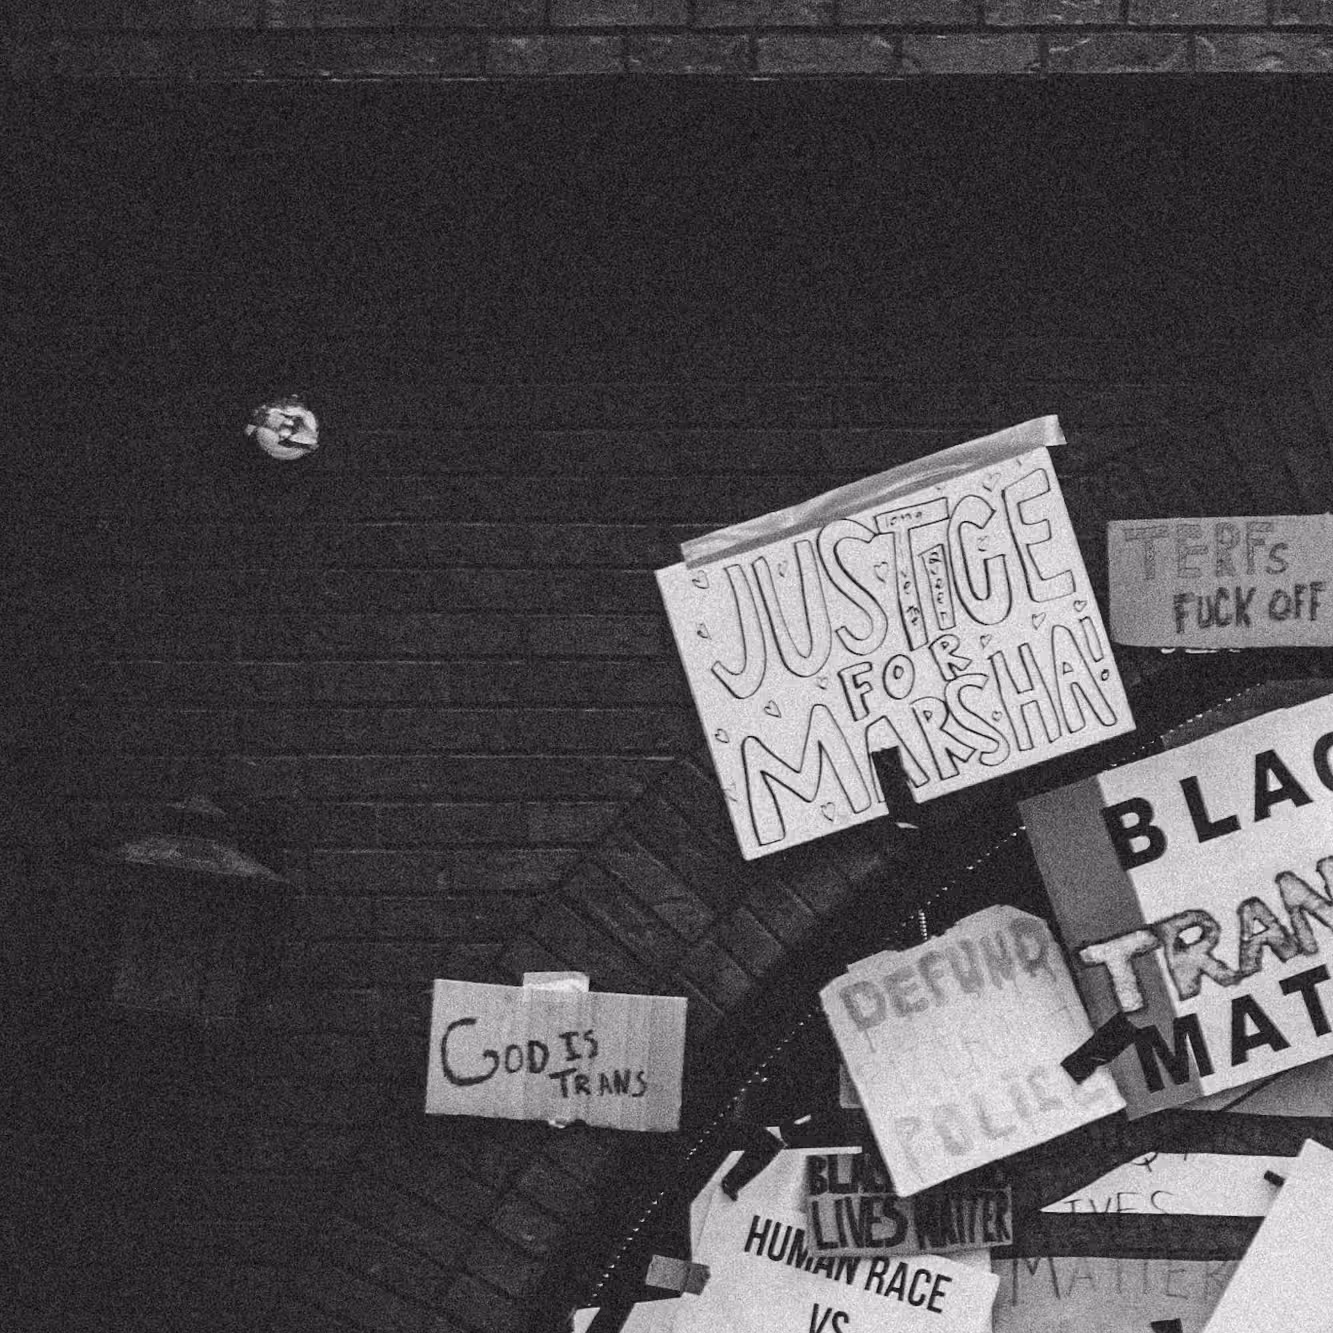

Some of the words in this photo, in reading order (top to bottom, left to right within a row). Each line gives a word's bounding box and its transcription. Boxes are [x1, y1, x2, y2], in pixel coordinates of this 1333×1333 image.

[711, 468, 1077, 700] JUSTICE
[1124, 522, 1288, 580] TERFS
[1174, 587, 1256, 634] FUCK
[1268, 581, 1325, 621] OFF
[838, 634, 971, 721] FOR
[740, 617, 1117, 846] MARSHA!
[840, 917, 1050, 1033] DEFUND
[550, 1068, 648, 1098] TRANS
[559, 1029, 598, 1061] IS
[744, 1215, 860, 1286] HUMAN
[865, 1255, 952, 1315] RACE
